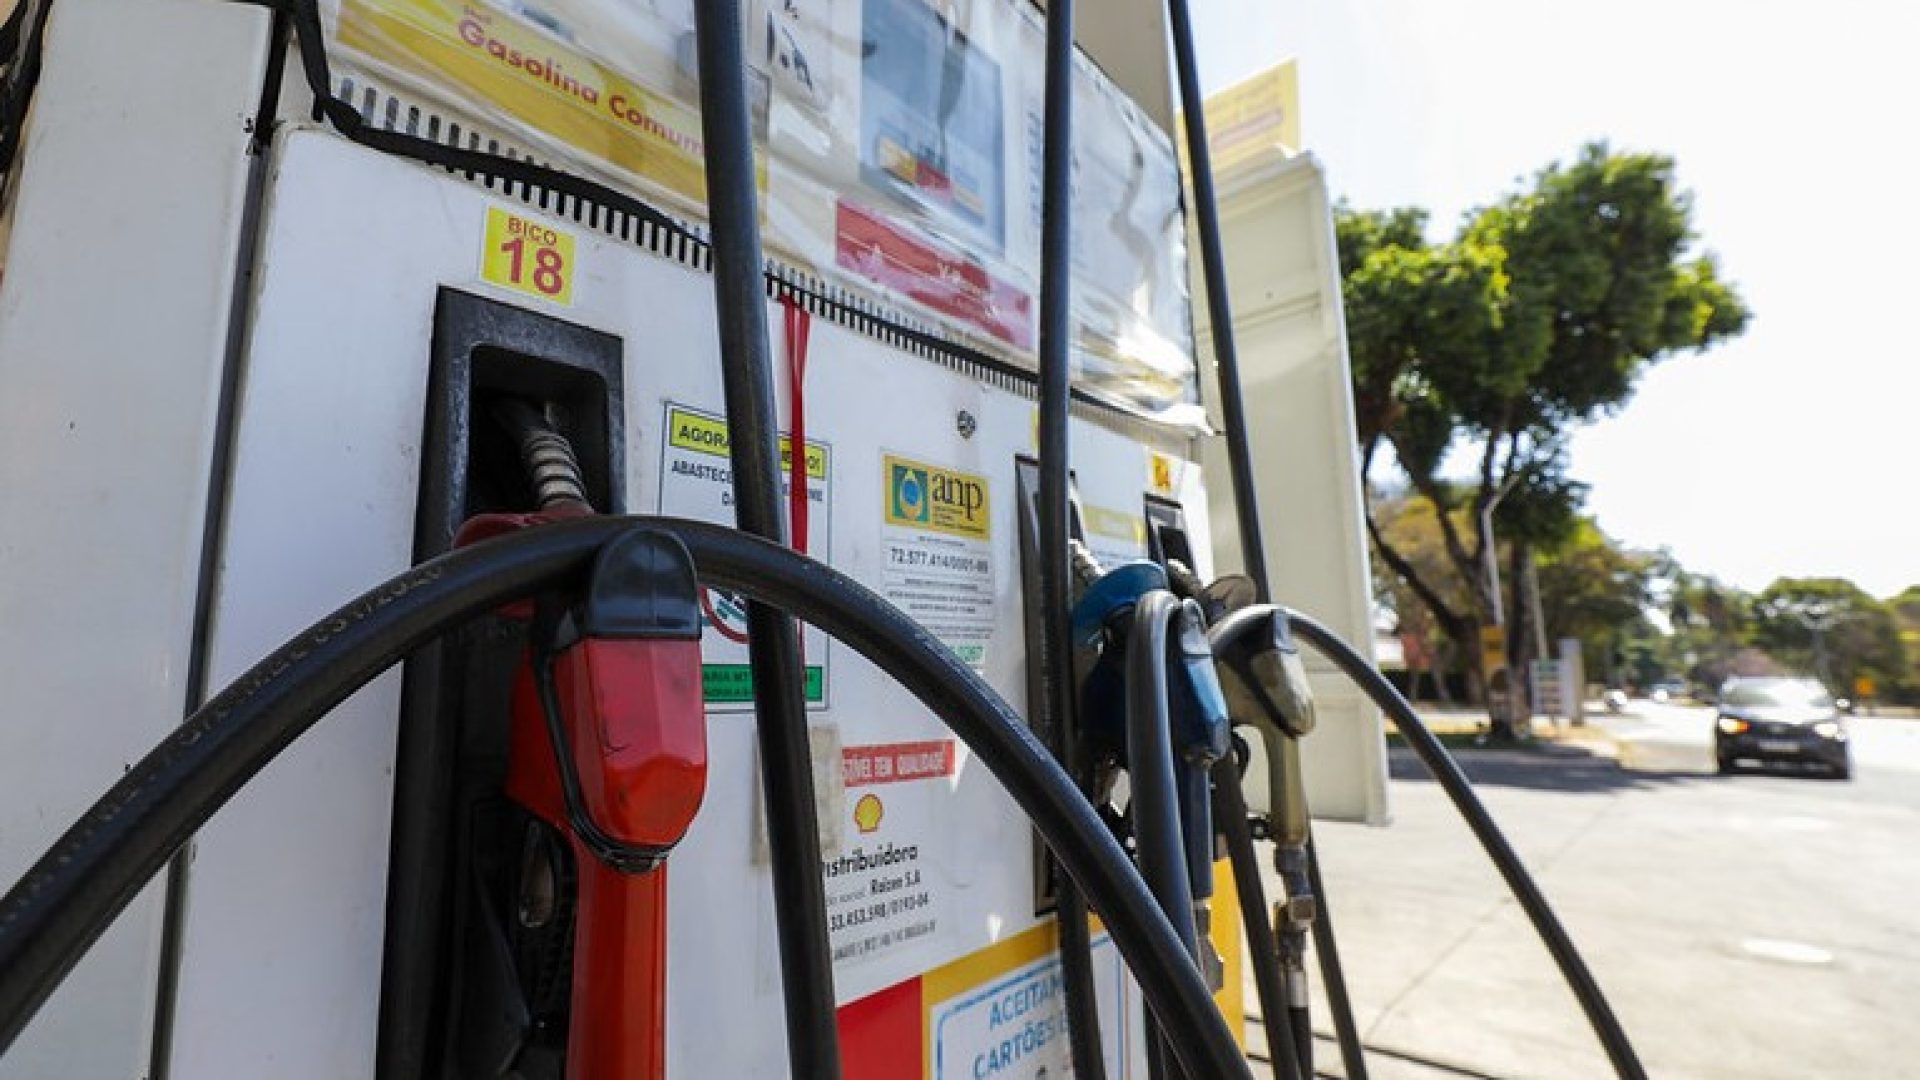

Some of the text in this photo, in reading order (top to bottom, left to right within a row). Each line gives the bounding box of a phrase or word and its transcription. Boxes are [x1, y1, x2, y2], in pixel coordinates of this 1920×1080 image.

[458, 18, 600, 106] Gasolina
[508, 216, 558, 247] BICO
[499, 238, 563, 296] 18
[679, 424, 729, 447] AGOR
[671, 460, 733, 484] ABASTECE
[932, 473, 984, 521] anp
[822, 841, 918, 878] istribuidora
